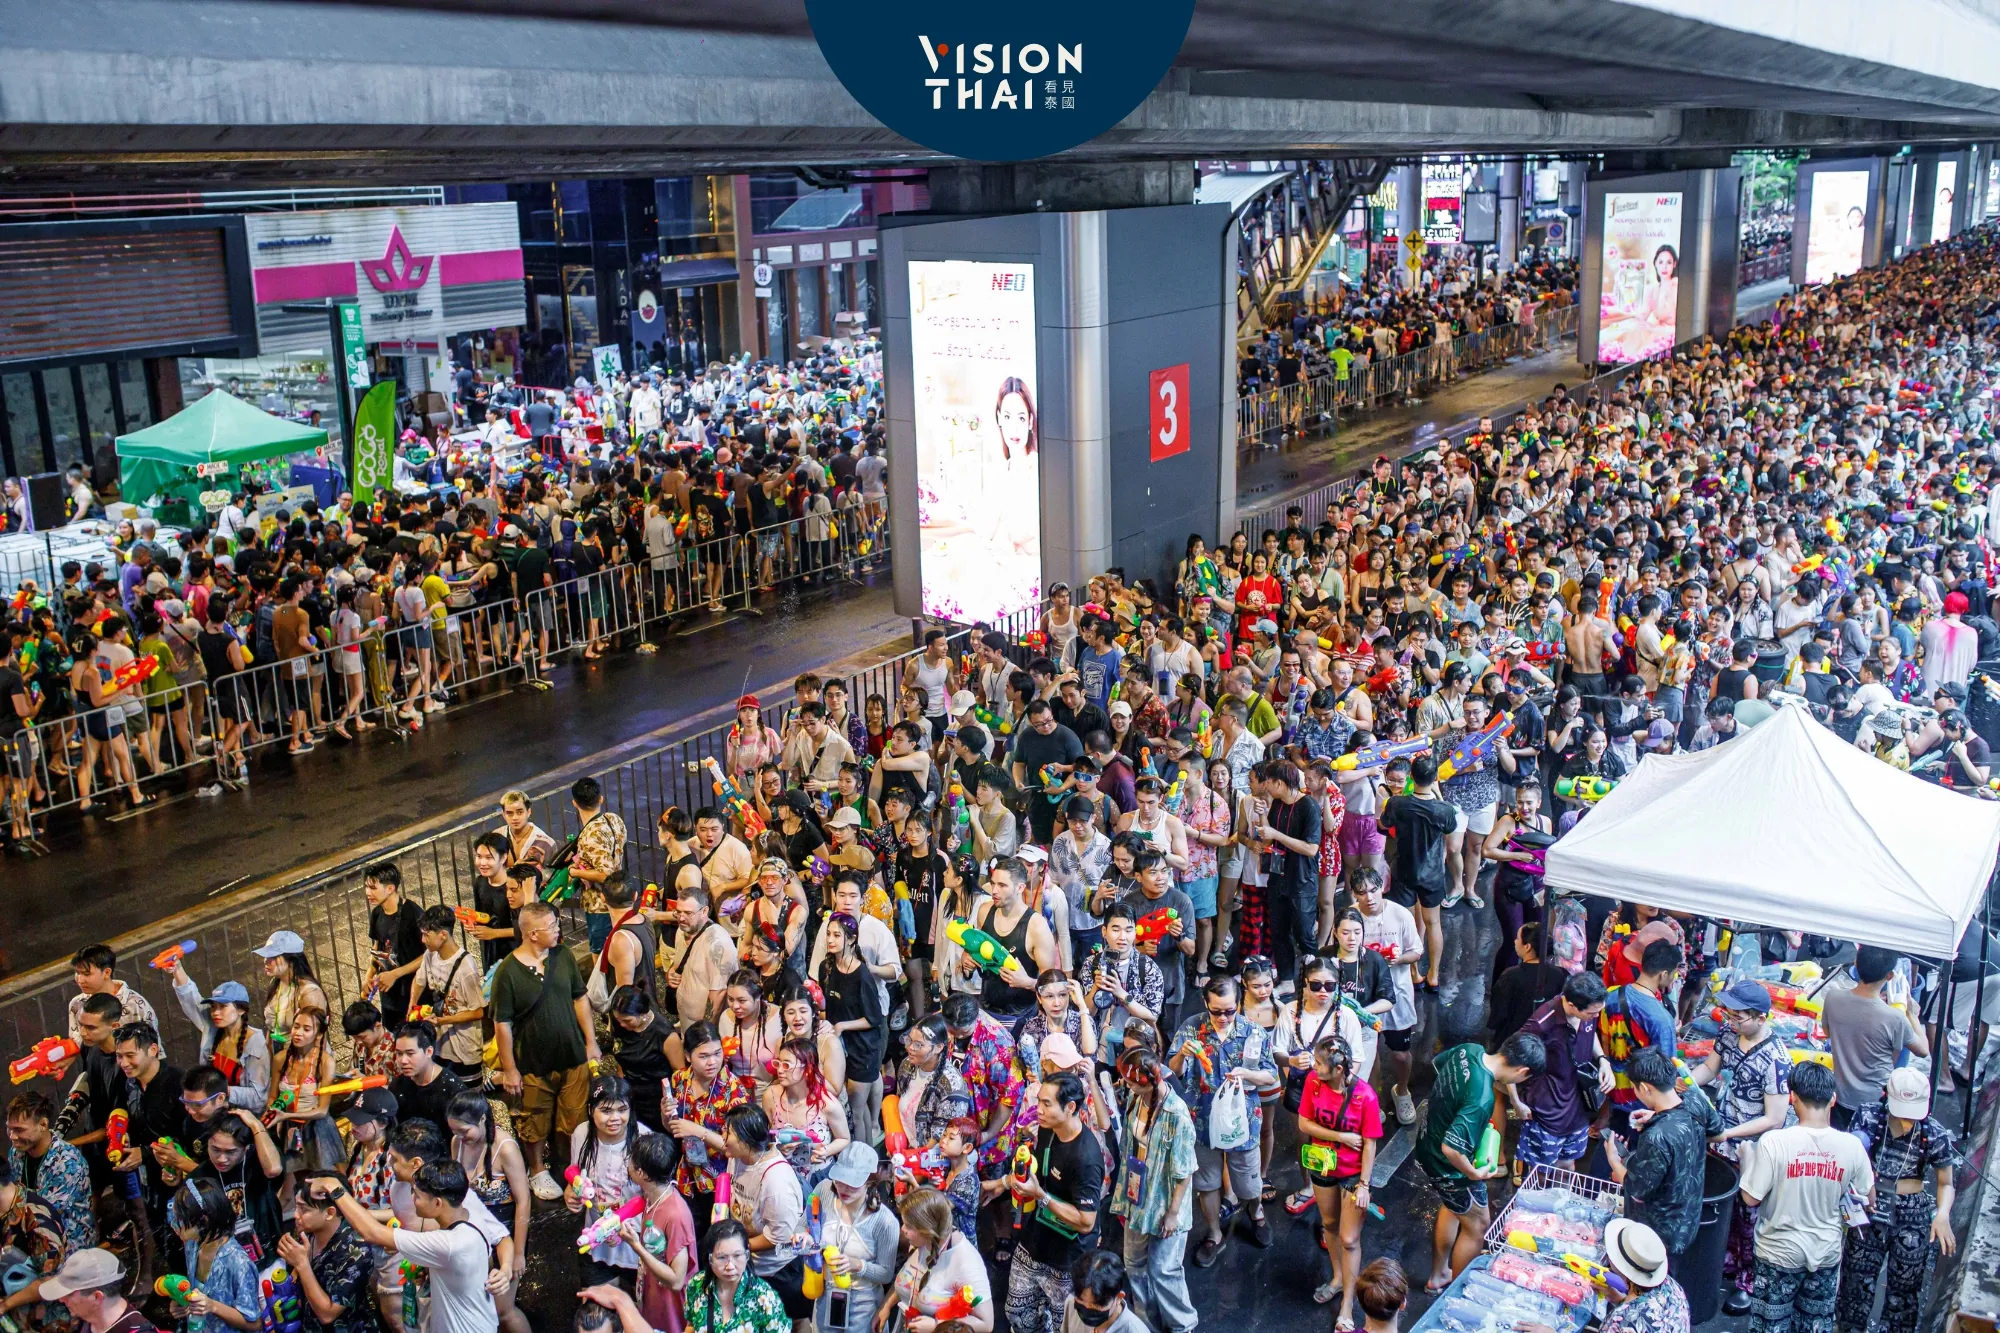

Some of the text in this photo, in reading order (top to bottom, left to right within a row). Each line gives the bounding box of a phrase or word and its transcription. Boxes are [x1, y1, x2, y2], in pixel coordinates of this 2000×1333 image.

[1426, 229, 1460, 238] CLINIC
[991, 273, 1026, 292] NEO
[618, 269, 628, 319] YADA
[1158, 380, 1178, 446] 3
[1804, 1161, 1817, 1177] me
[1817, 1159, 1838, 1181] with
